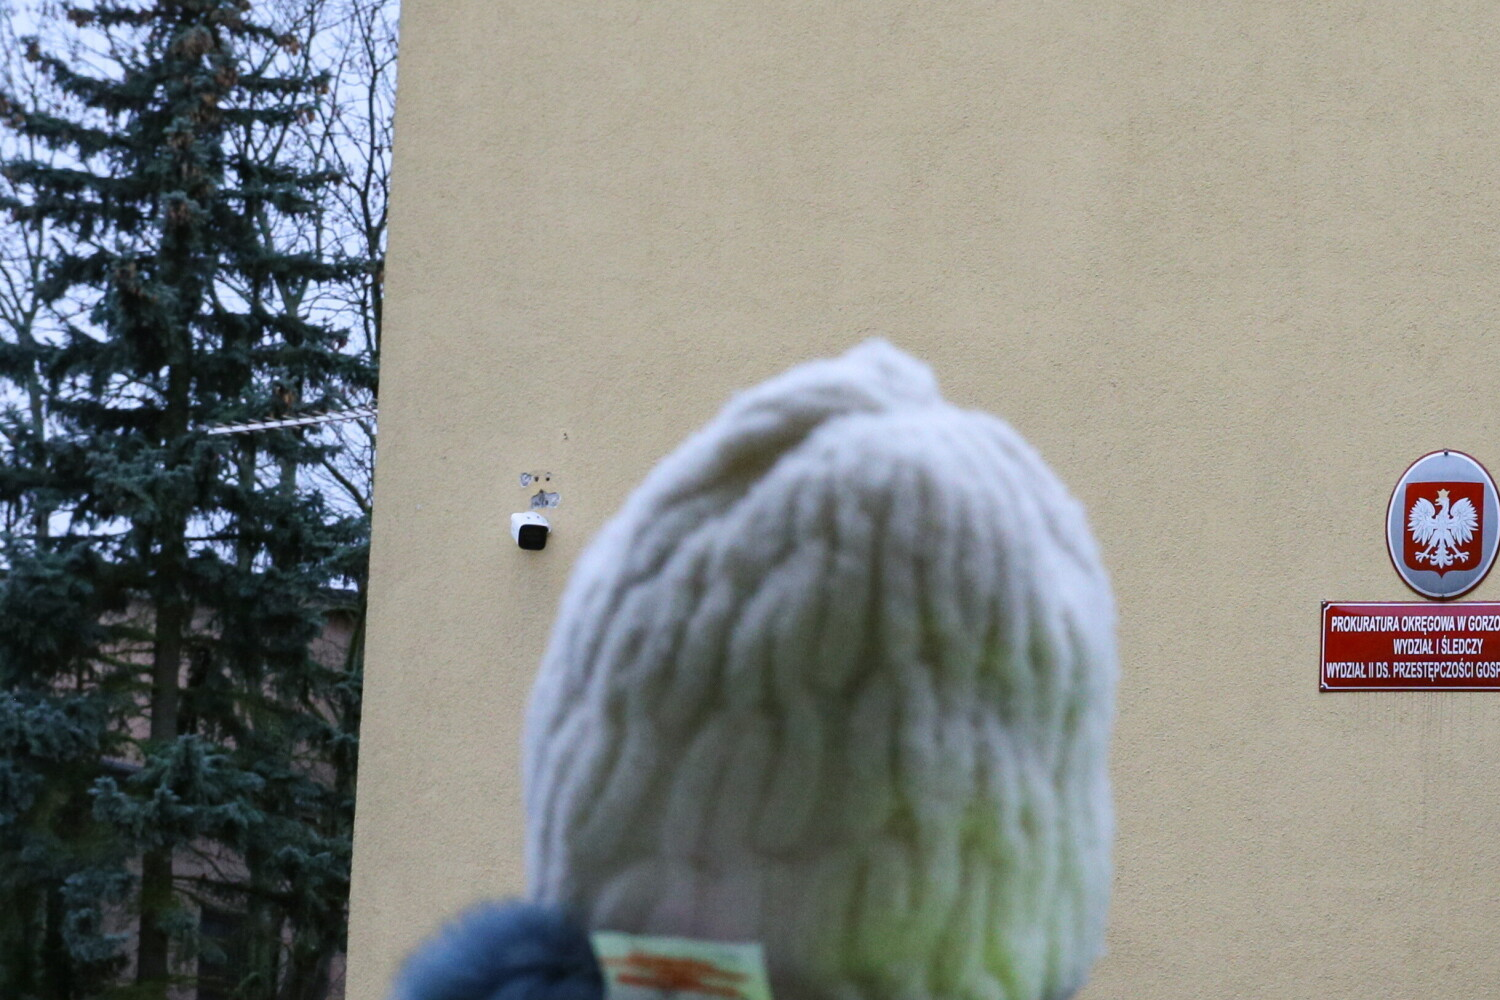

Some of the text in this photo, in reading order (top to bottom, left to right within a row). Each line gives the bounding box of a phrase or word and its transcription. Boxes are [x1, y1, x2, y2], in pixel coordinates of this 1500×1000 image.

[1331, 616, 1400, 632] PROKURATURA
[1401, 615, 1455, 635] OKRĘGOWA
[1457, 615, 1467, 632] W
[1393, 634, 1483, 655] WYDZIAŁ I ŚLEDCZY
[1326, 662, 1367, 678] WYDZIAŁ
[1369, 662, 1374, 678] II
[1376, 662, 1391, 678] DS.
[1393, 658, 1474, 682] PRZESTĘPCZOŚCI
